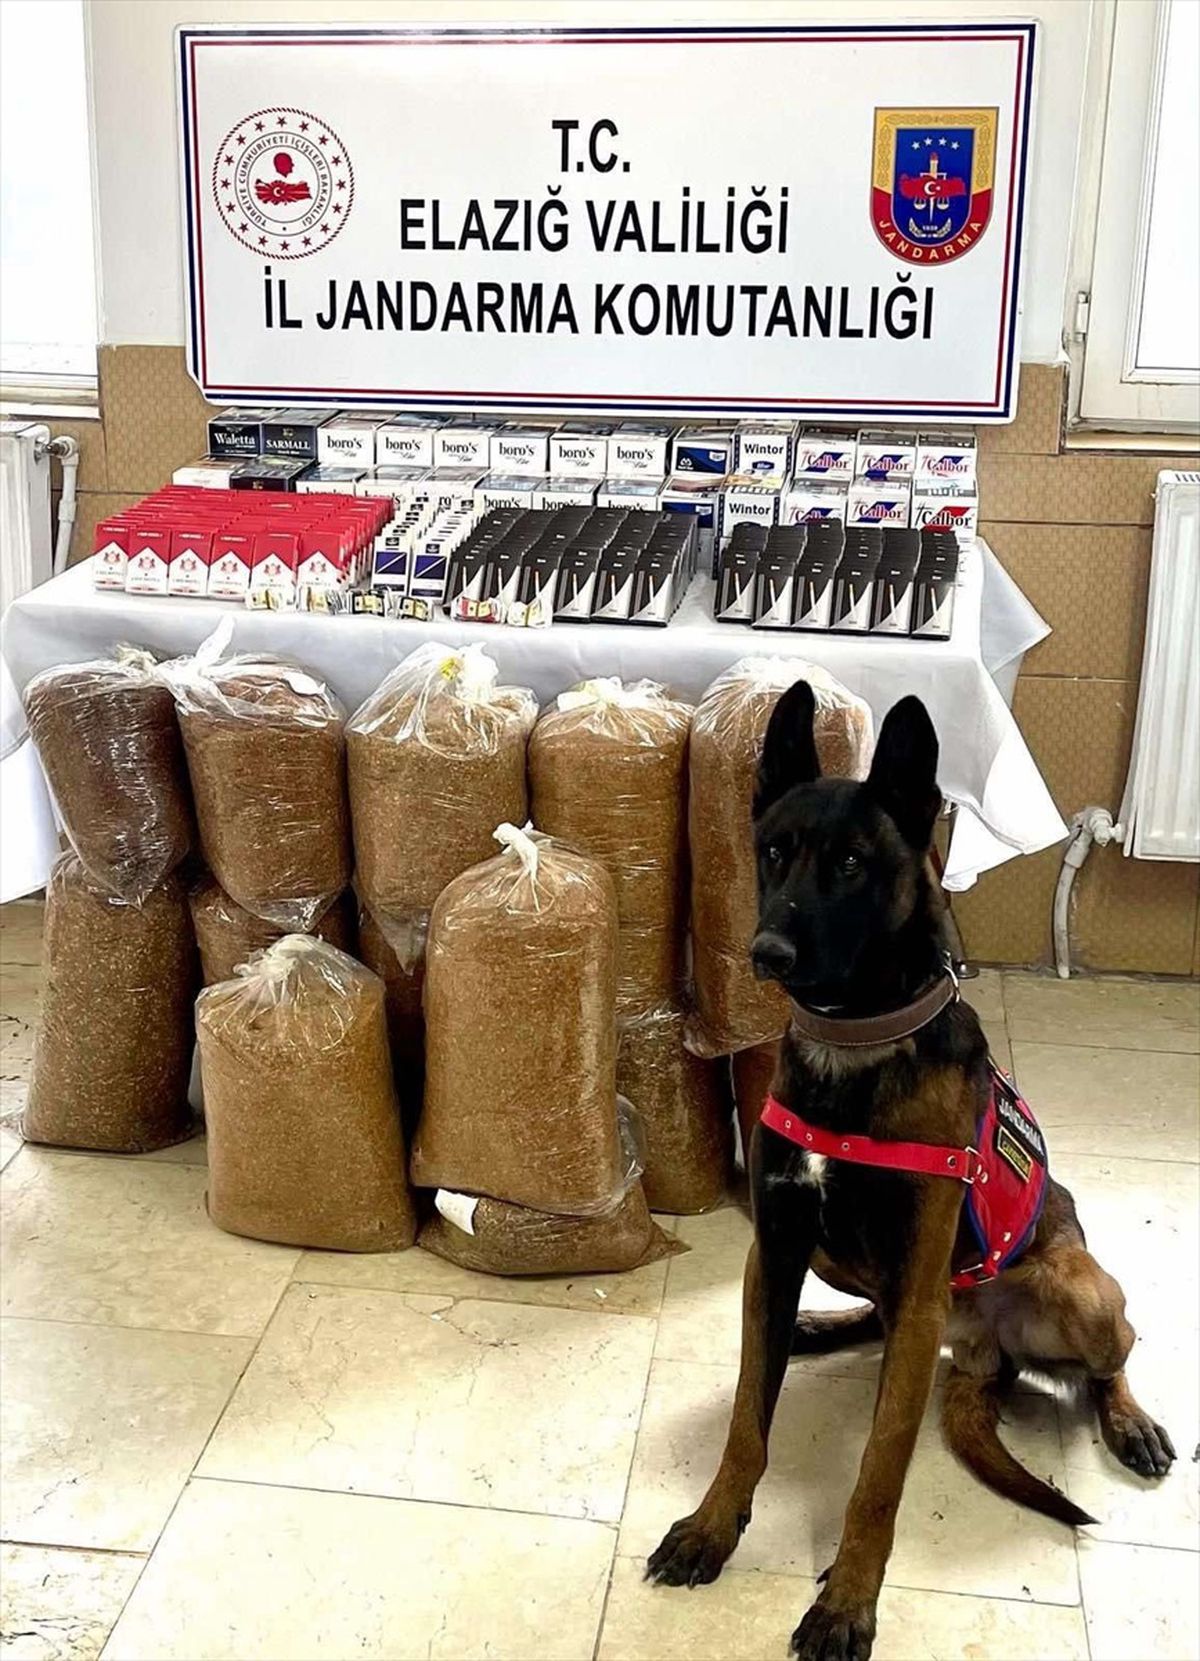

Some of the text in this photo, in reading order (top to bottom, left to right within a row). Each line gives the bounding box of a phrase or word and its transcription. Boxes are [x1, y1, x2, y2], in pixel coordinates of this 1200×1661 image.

[551, 118, 631, 173] T.C.
[400, 185, 789, 254] ELAZIĞ VALİLİĞİ
[879, 220, 982, 260] JANDARMA
[264, 266, 934, 340] İL JANDARMA KOMUTANLIĞI
[214, 432, 256, 446] Waletta
[266, 439, 311, 450] SARMALL
[327, 435, 362, 449] boro's
[385, 437, 421, 451] boro's
[442, 440, 477, 454] boro's
[499, 442, 535, 456] boro's
[558, 445, 596, 459] boro's
[617, 446, 654, 460] boro's
